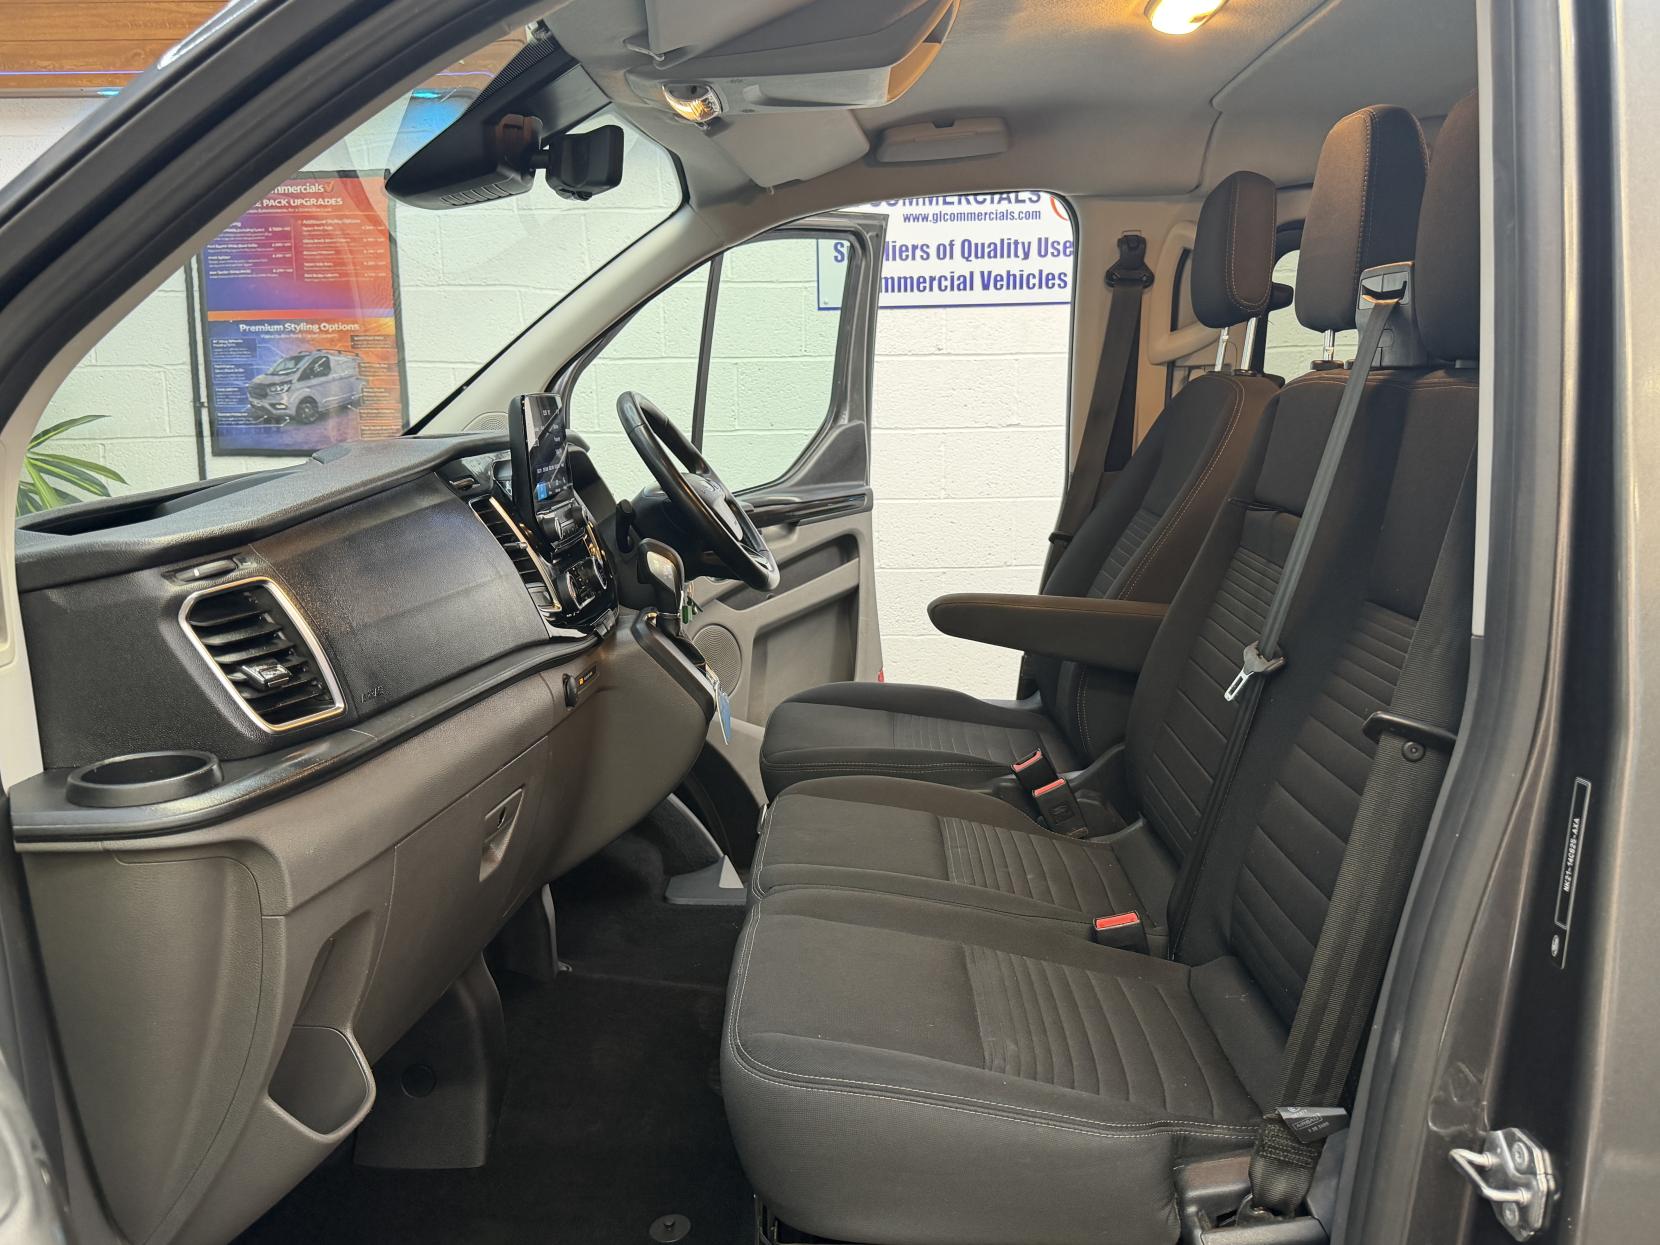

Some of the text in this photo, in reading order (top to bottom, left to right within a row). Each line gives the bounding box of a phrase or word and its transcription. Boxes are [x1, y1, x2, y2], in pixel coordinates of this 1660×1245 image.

[271, 183, 324, 194] mmercials
[263, 198, 289, 207] PACK
[290, 197, 343, 206] UPGRADES
[902, 208, 1042, 224] www.glcommercials.com
[833, 236, 1074, 263] Sliers of Quality Use
[880, 268, 1069, 293] mmercial Vehicles
[239, 321, 360, 333] Premium Styling Options
